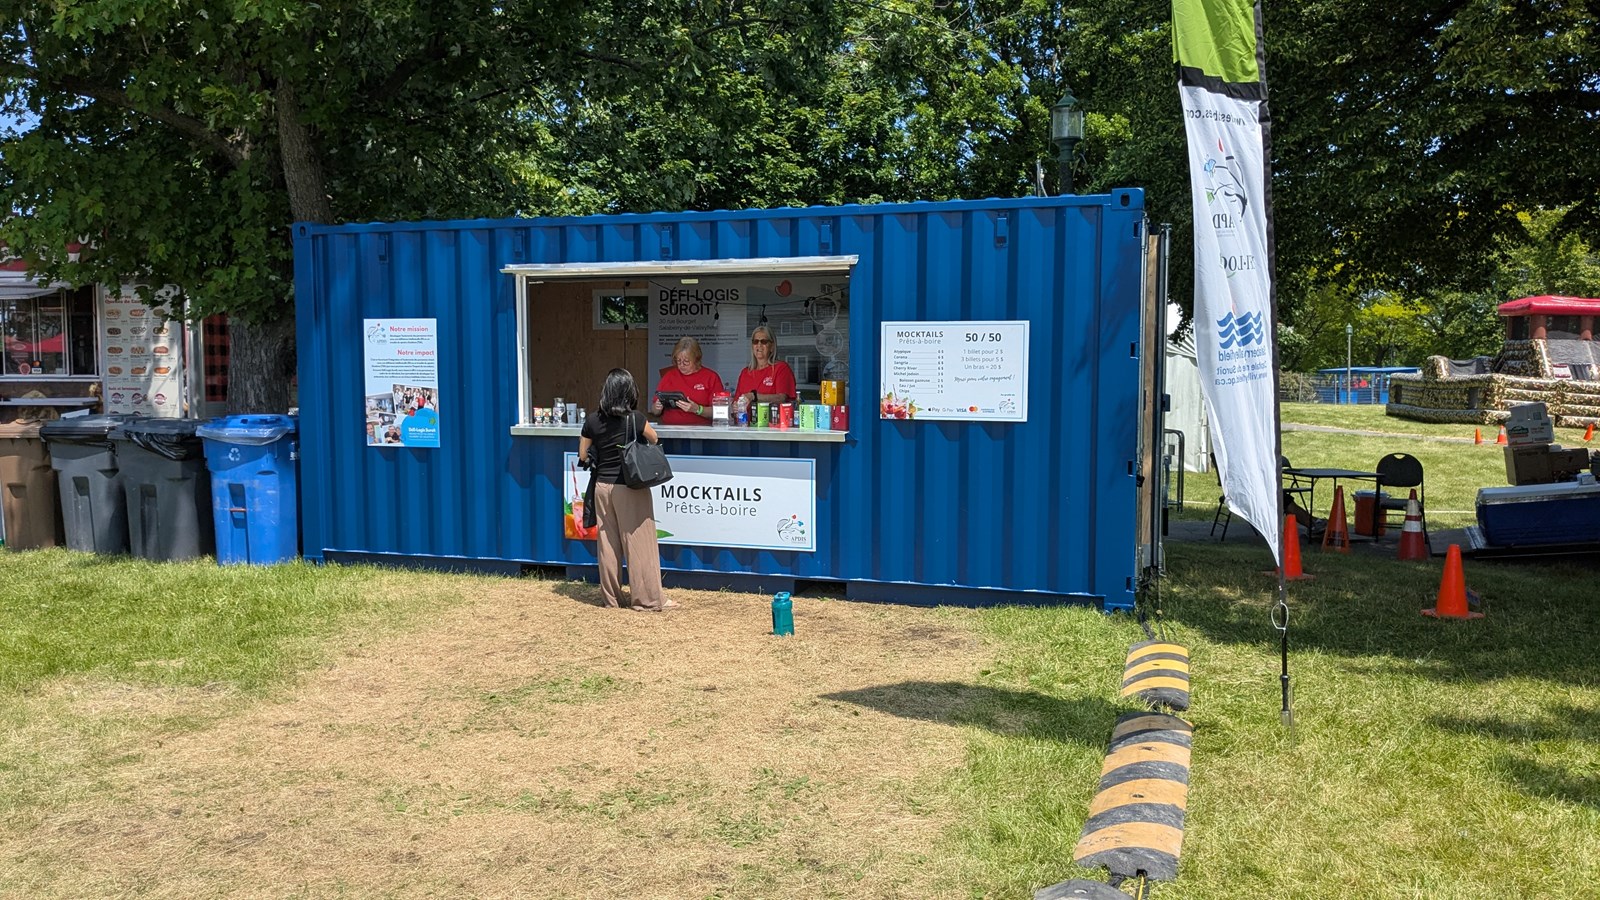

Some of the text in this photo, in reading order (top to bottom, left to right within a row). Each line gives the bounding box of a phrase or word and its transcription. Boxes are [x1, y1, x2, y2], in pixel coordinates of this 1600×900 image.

[660, 287, 739, 302] DÉFI-LOGIS
[965, 333, 1002, 342] 50 / 50
[661, 484, 763, 502] MOCKTAILS
[665, 501, 757, 517] Prêts-à-boire
